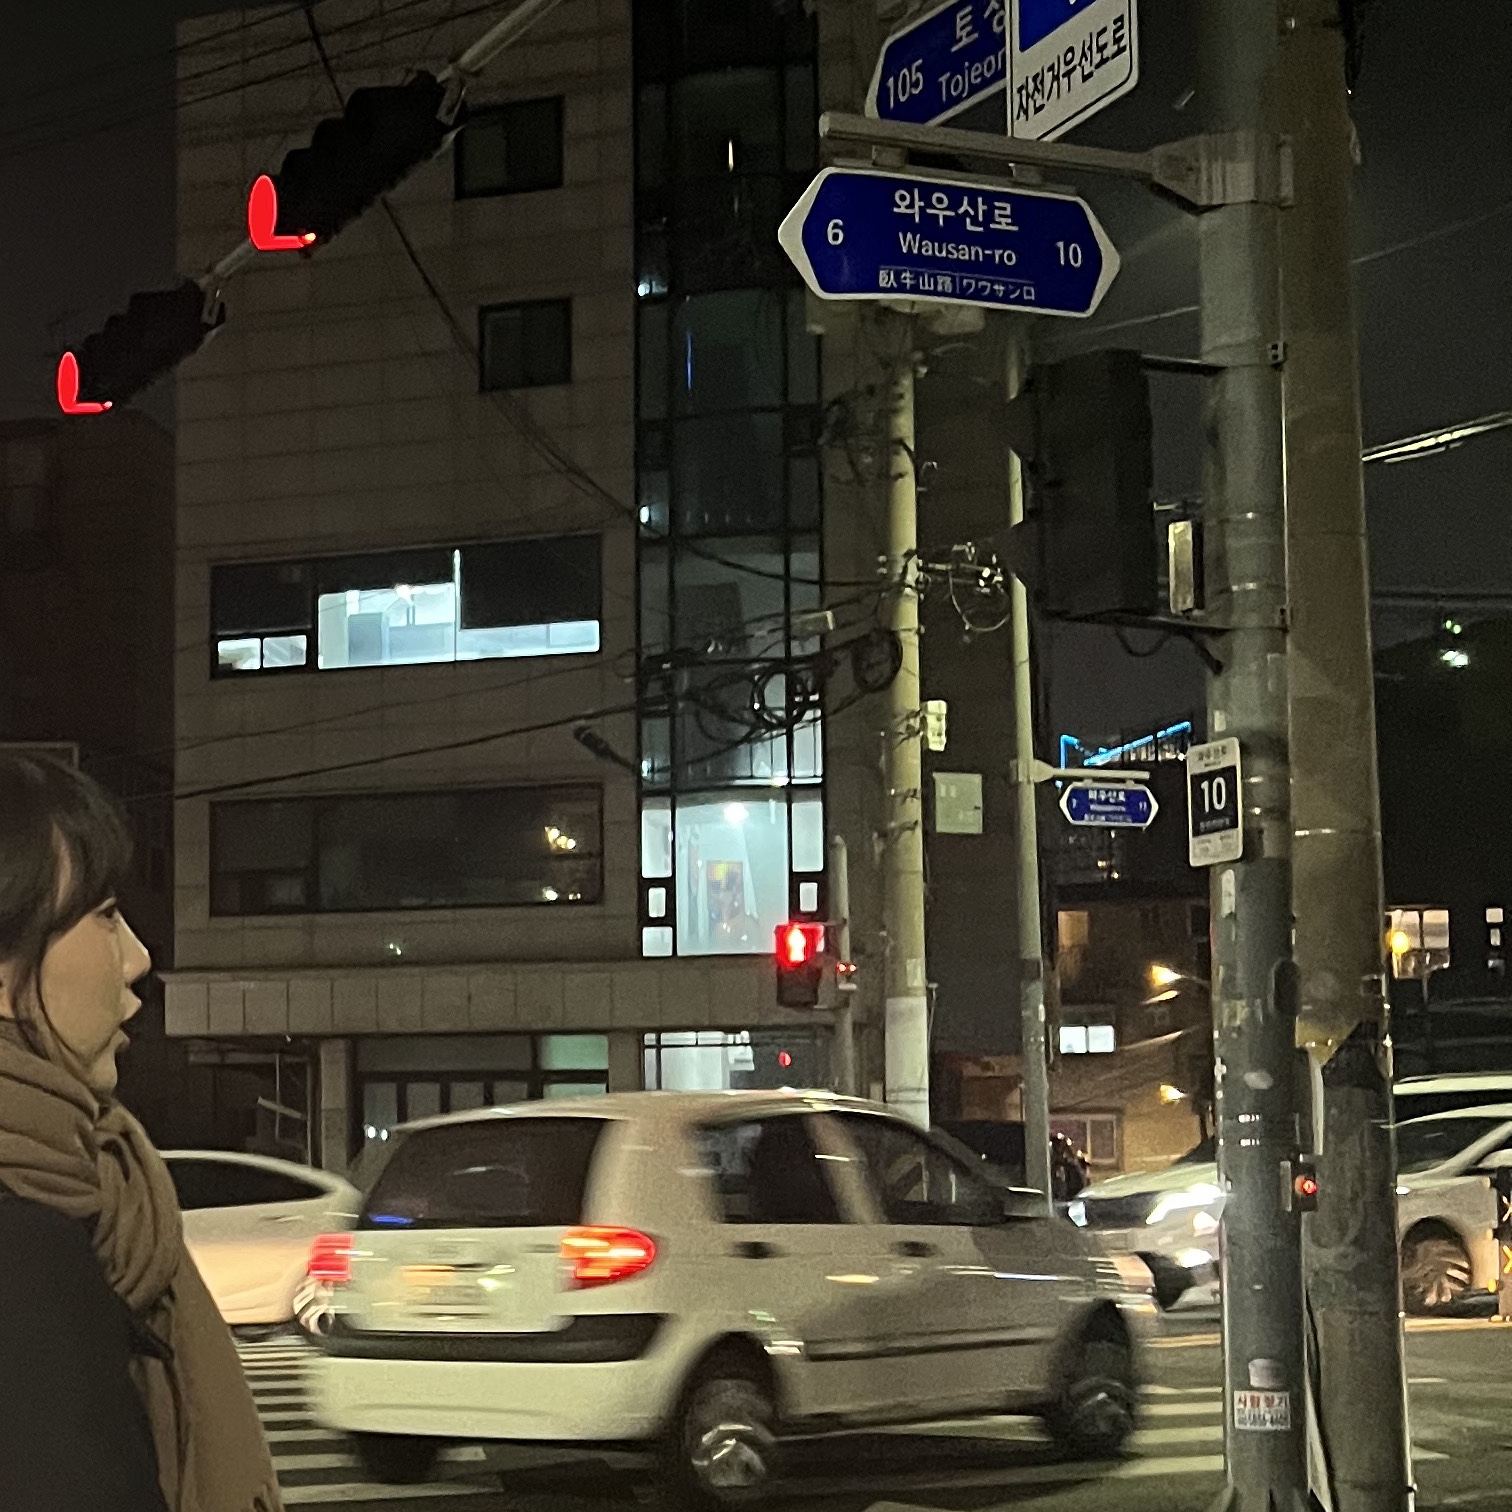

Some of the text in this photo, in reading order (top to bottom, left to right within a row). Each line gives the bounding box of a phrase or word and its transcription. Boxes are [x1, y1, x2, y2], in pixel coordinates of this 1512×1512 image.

[886, 59, 924, 110] 105
[1016, 13, 1127, 122] 자전거우선도로
[893, 188, 1020, 233] 와우산로
[826, 219, 845, 245] 6
[898, 231, 1017, 266] Wausan-ro
[1056, 241, 1082, 268] 10
[1200, 776, 1226, 814] 10
